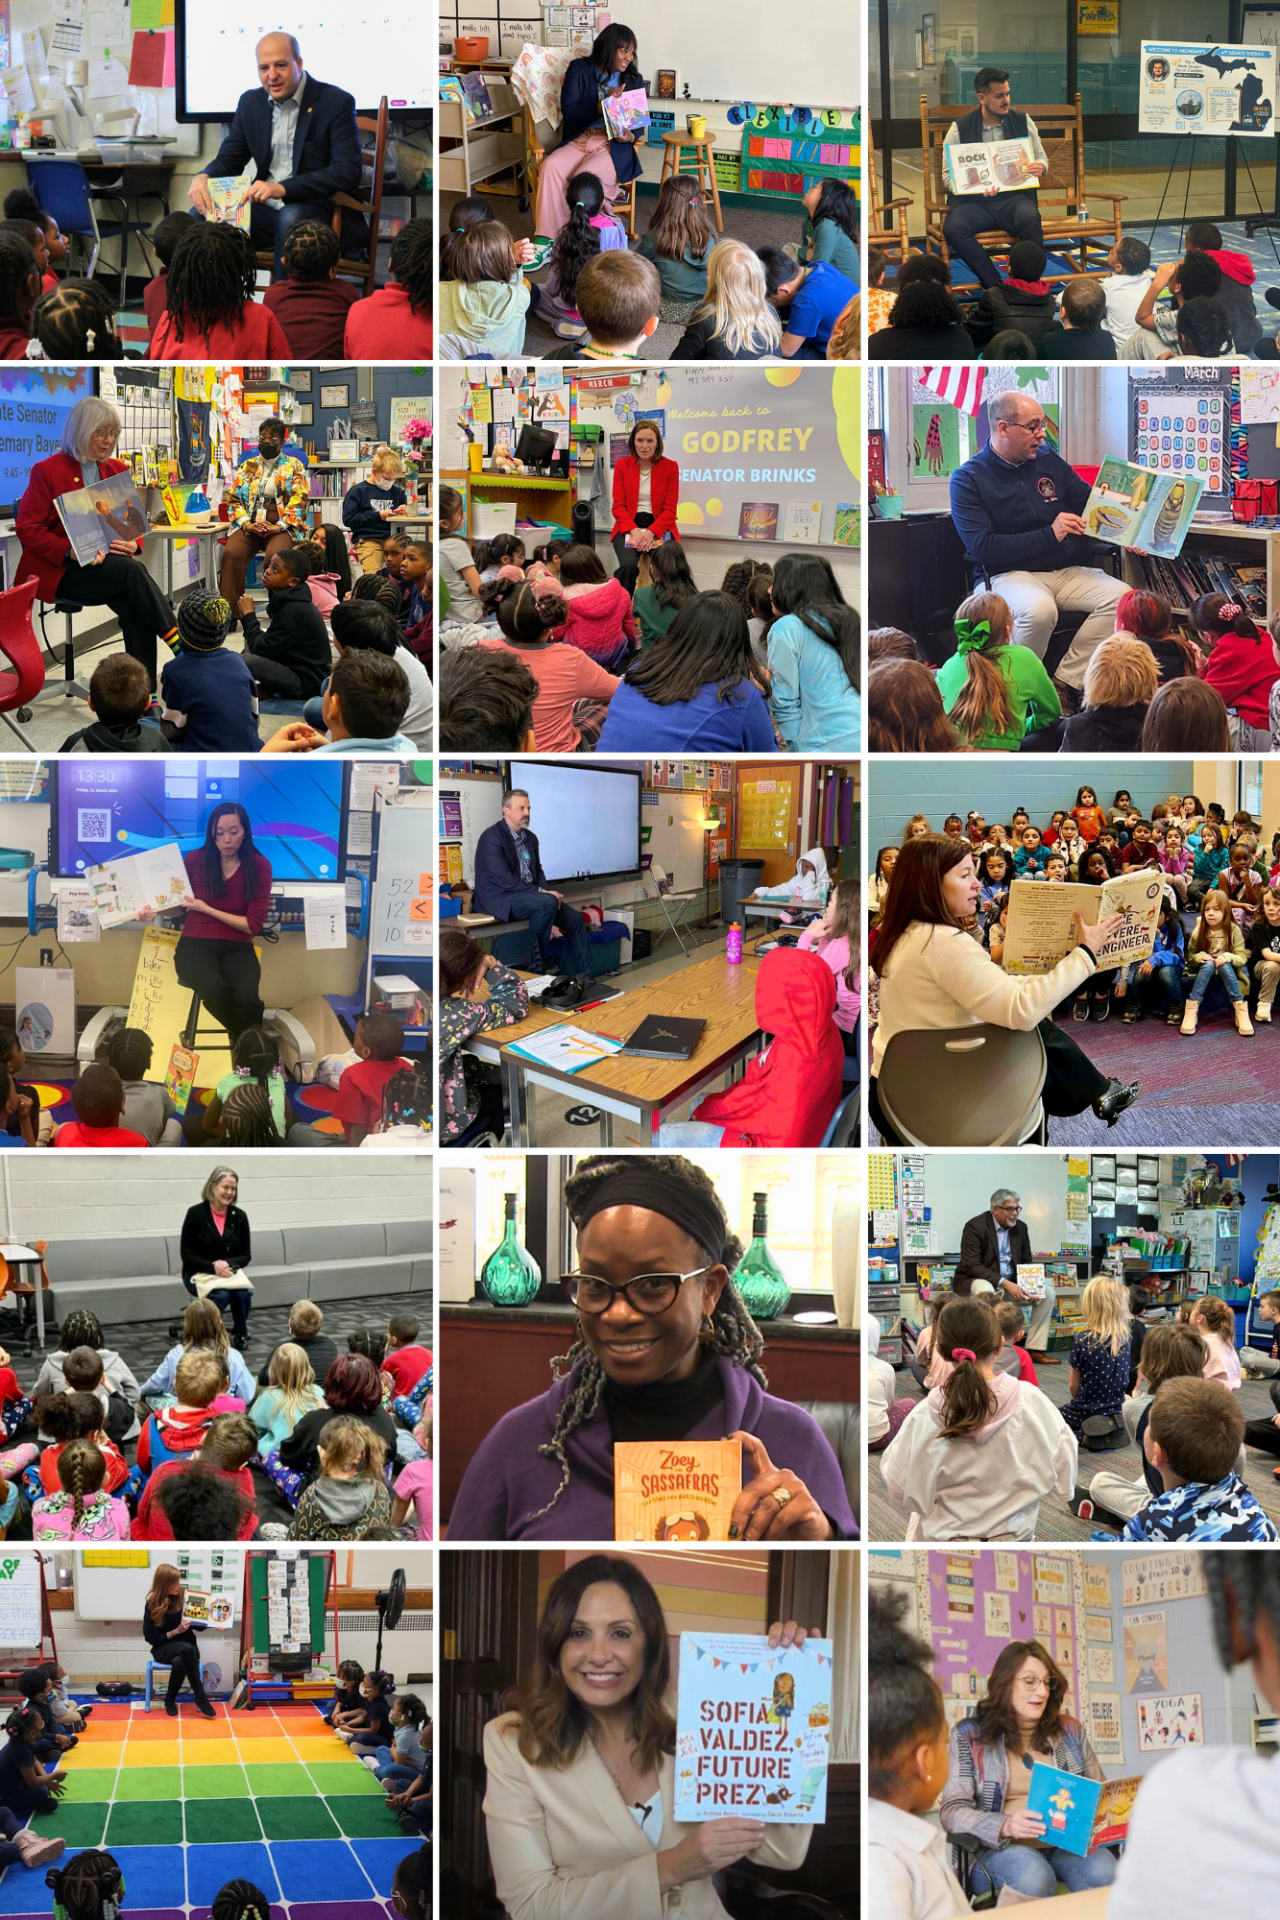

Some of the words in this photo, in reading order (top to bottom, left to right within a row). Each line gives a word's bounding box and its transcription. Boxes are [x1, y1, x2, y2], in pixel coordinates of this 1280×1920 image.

[958, 153, 986, 164] ROCK
[1184, 366, 1219, 379] March
[588, 379, 613, 388] MARCH
[17, 403, 57, 424] Senator
[668, 408, 718, 419] Welcome
[722, 405, 753, 417] back
[757, 406, 772, 415] to
[682, 427, 814, 454] GODFREY
[750, 468, 816, 483] BRINKS
[744, 511, 774, 524] BECAUSE
[837, 522, 852, 540] WHAT
[78, 769, 114, 783] 13:30
[388, 878, 413, 896] 52
[387, 901, 405, 919] 12
[385, 927, 401, 942] 10
[1113, 924, 1142, 939] VERE,
[1018, 1266, 1042, 1275] DUCK
[660, 1450, 700, 1472] Zoey
[641, 1473, 719, 1498] SASSAFRAS
[3, 1559, 20, 1570] OF
[1124, 1556, 1171, 1575] COUNTING
[1171, 1566, 1179, 1575] 10
[1125, 1588, 1133, 1603] 10
[1136, 1586, 1141, 1602] 9
[1160, 1582, 1165, 1597] 6
[1175, 1579, 1181, 1594] 4
[1129, 1616, 1140, 1625] CAN
[1141, 1612, 1163, 1624] CONTROL
[1092, 1702, 1113, 1719] BELIEVE
[1153, 1697, 1186, 1709] YOGA
[700, 1700, 770, 1724] SOFIA
[700, 1728, 794, 1754] VALDEZ,
[697, 1756, 791, 1779] FUTURE
[696, 1783, 762, 1805] PREZ
[1102, 1790, 1111, 1798] ON
[1113, 1788, 1129, 1796] THE
